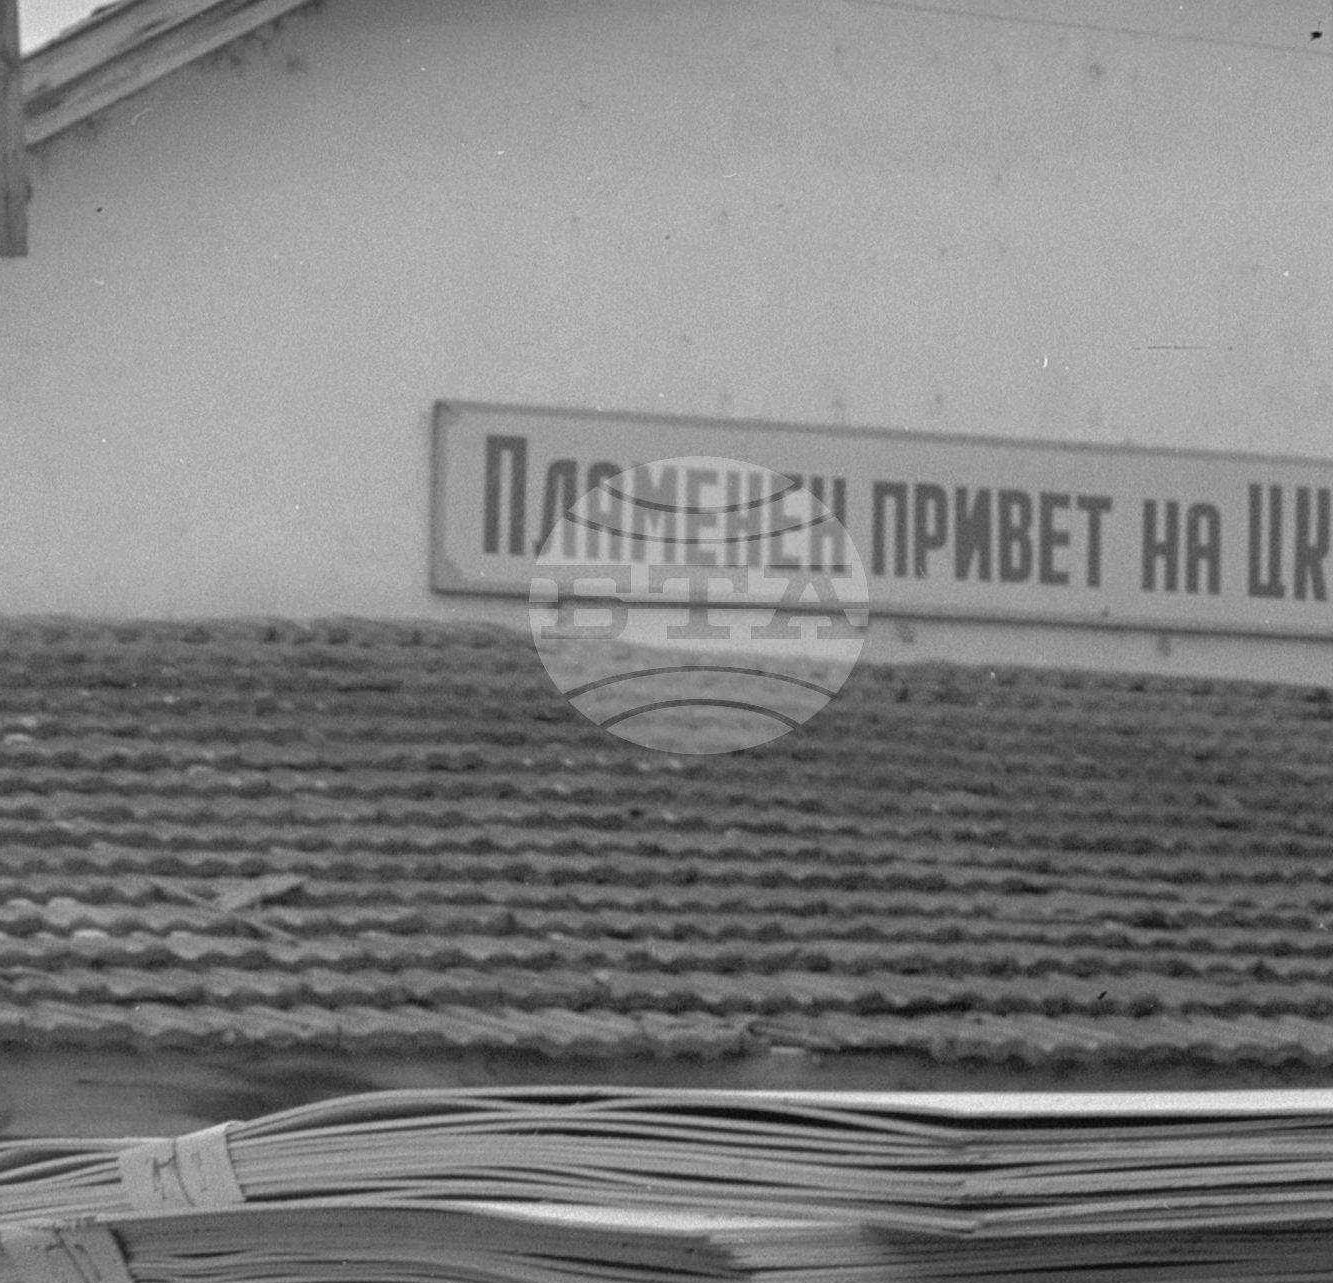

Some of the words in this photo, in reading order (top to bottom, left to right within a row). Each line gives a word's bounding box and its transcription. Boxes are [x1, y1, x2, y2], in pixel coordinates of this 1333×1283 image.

[871, 480, 1113, 588] ПРИВЕТ
[1141, 498, 1222, 595] НА
[1247, 482, 1332, 602] ЦК
